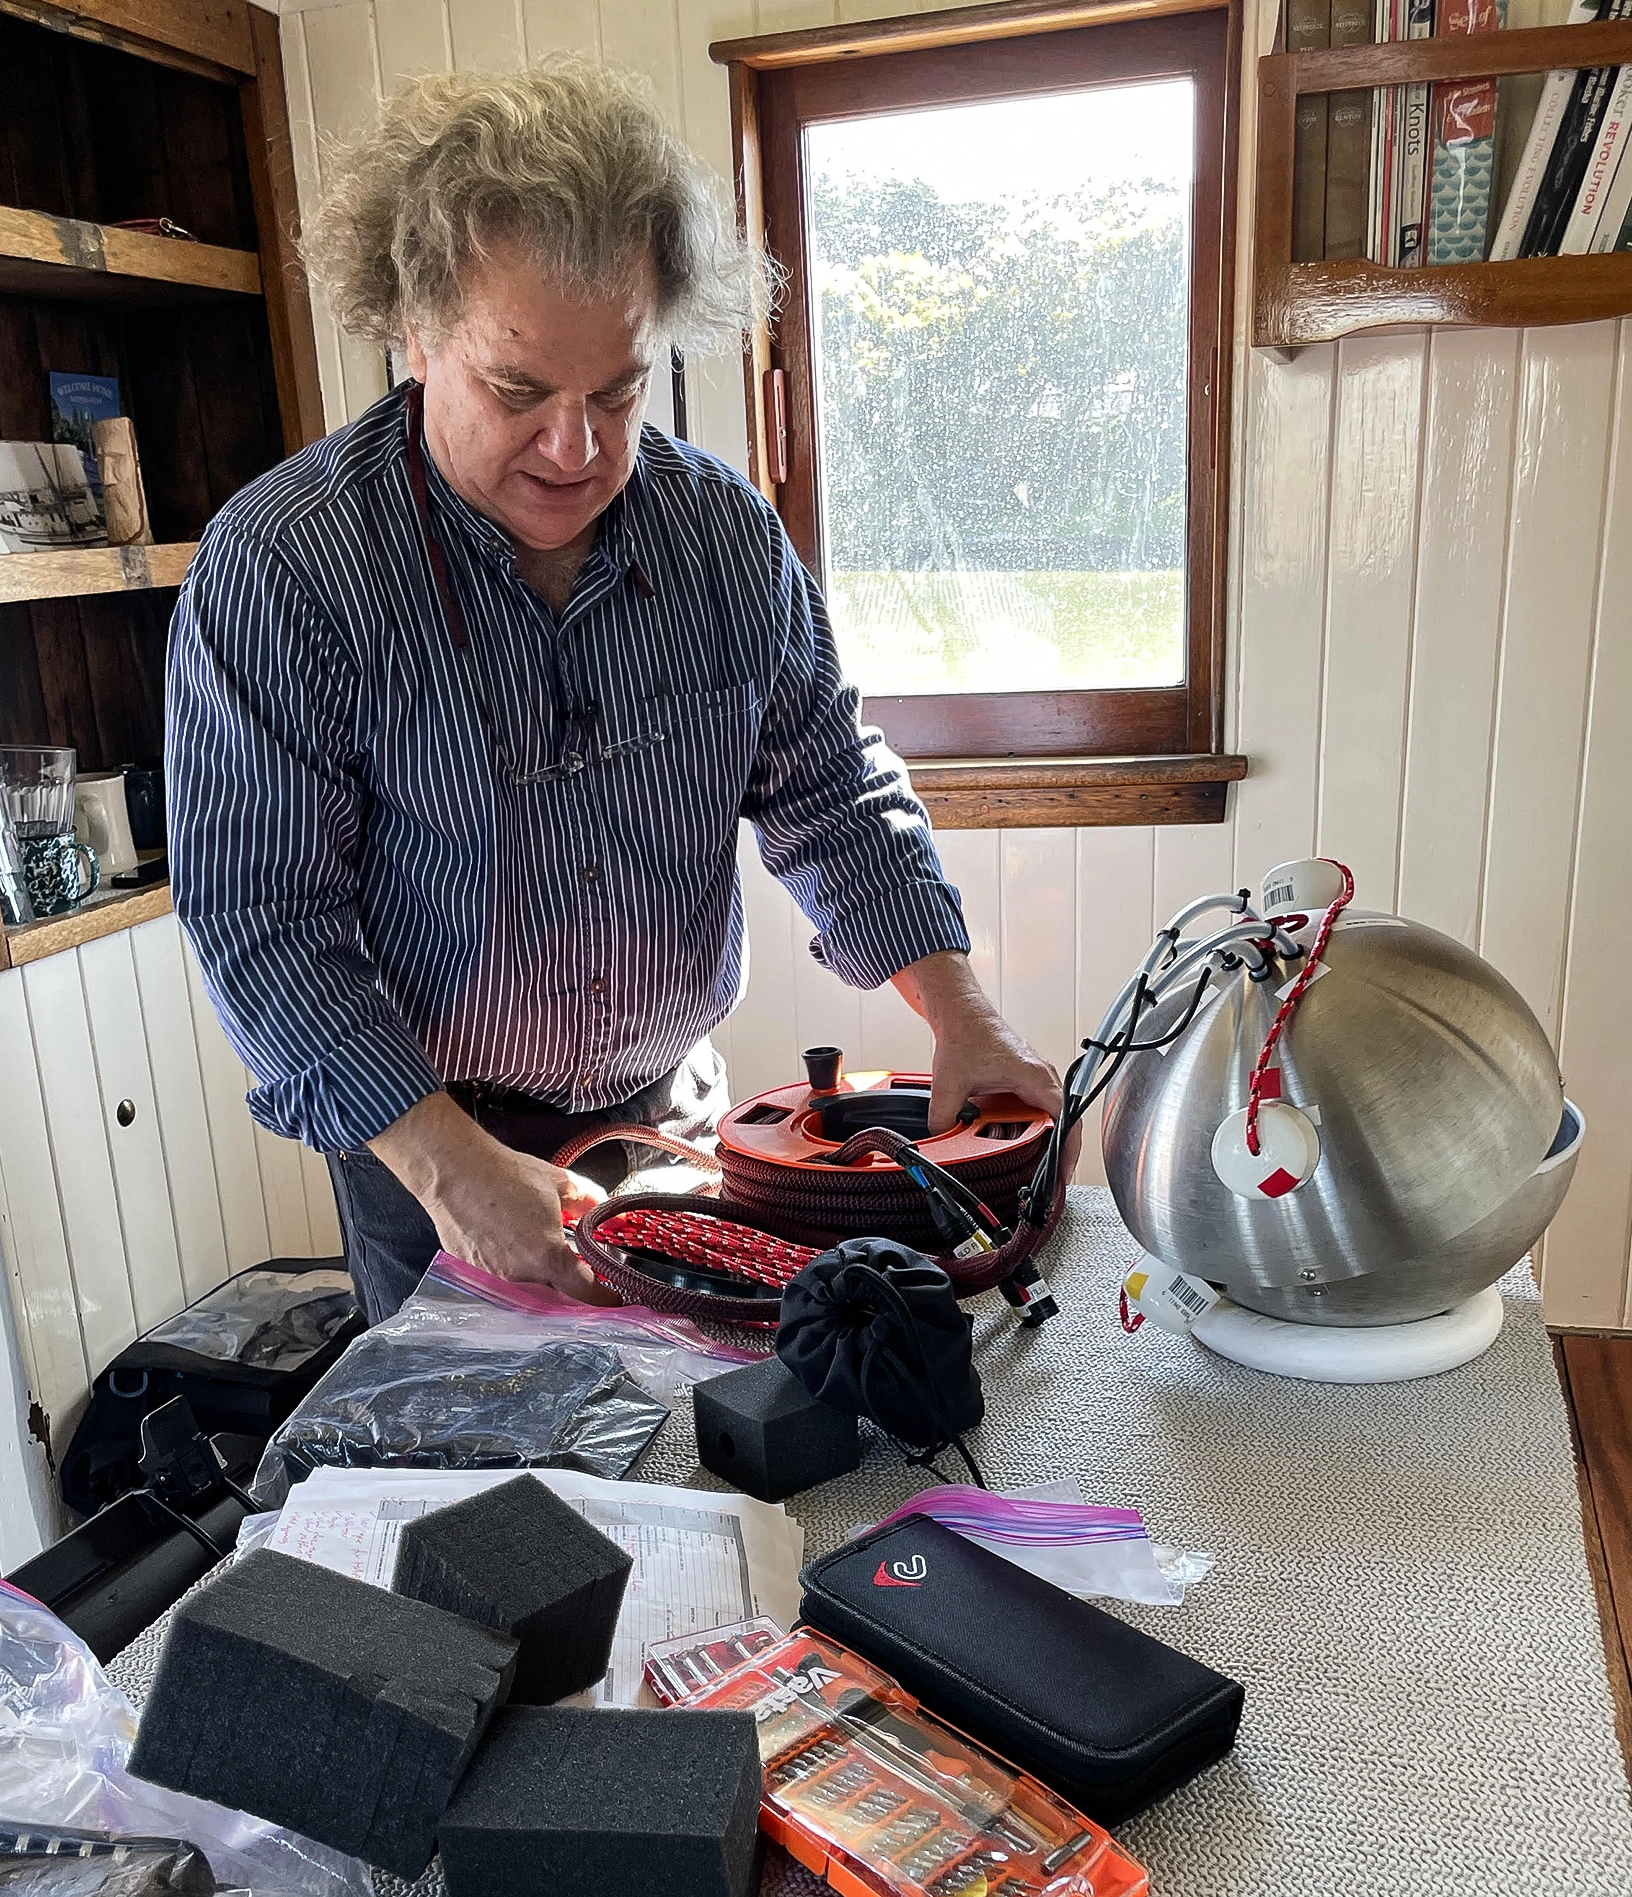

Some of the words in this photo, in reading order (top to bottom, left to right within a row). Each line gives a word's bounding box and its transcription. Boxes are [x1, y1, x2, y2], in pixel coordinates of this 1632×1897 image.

[1408, 103, 1424, 156] Knots
[1581, 121, 1620, 215] REVOLUTION
[1508, 166, 1536, 232] EVOLUTION
[755, 1666, 842, 1721] Vasta
